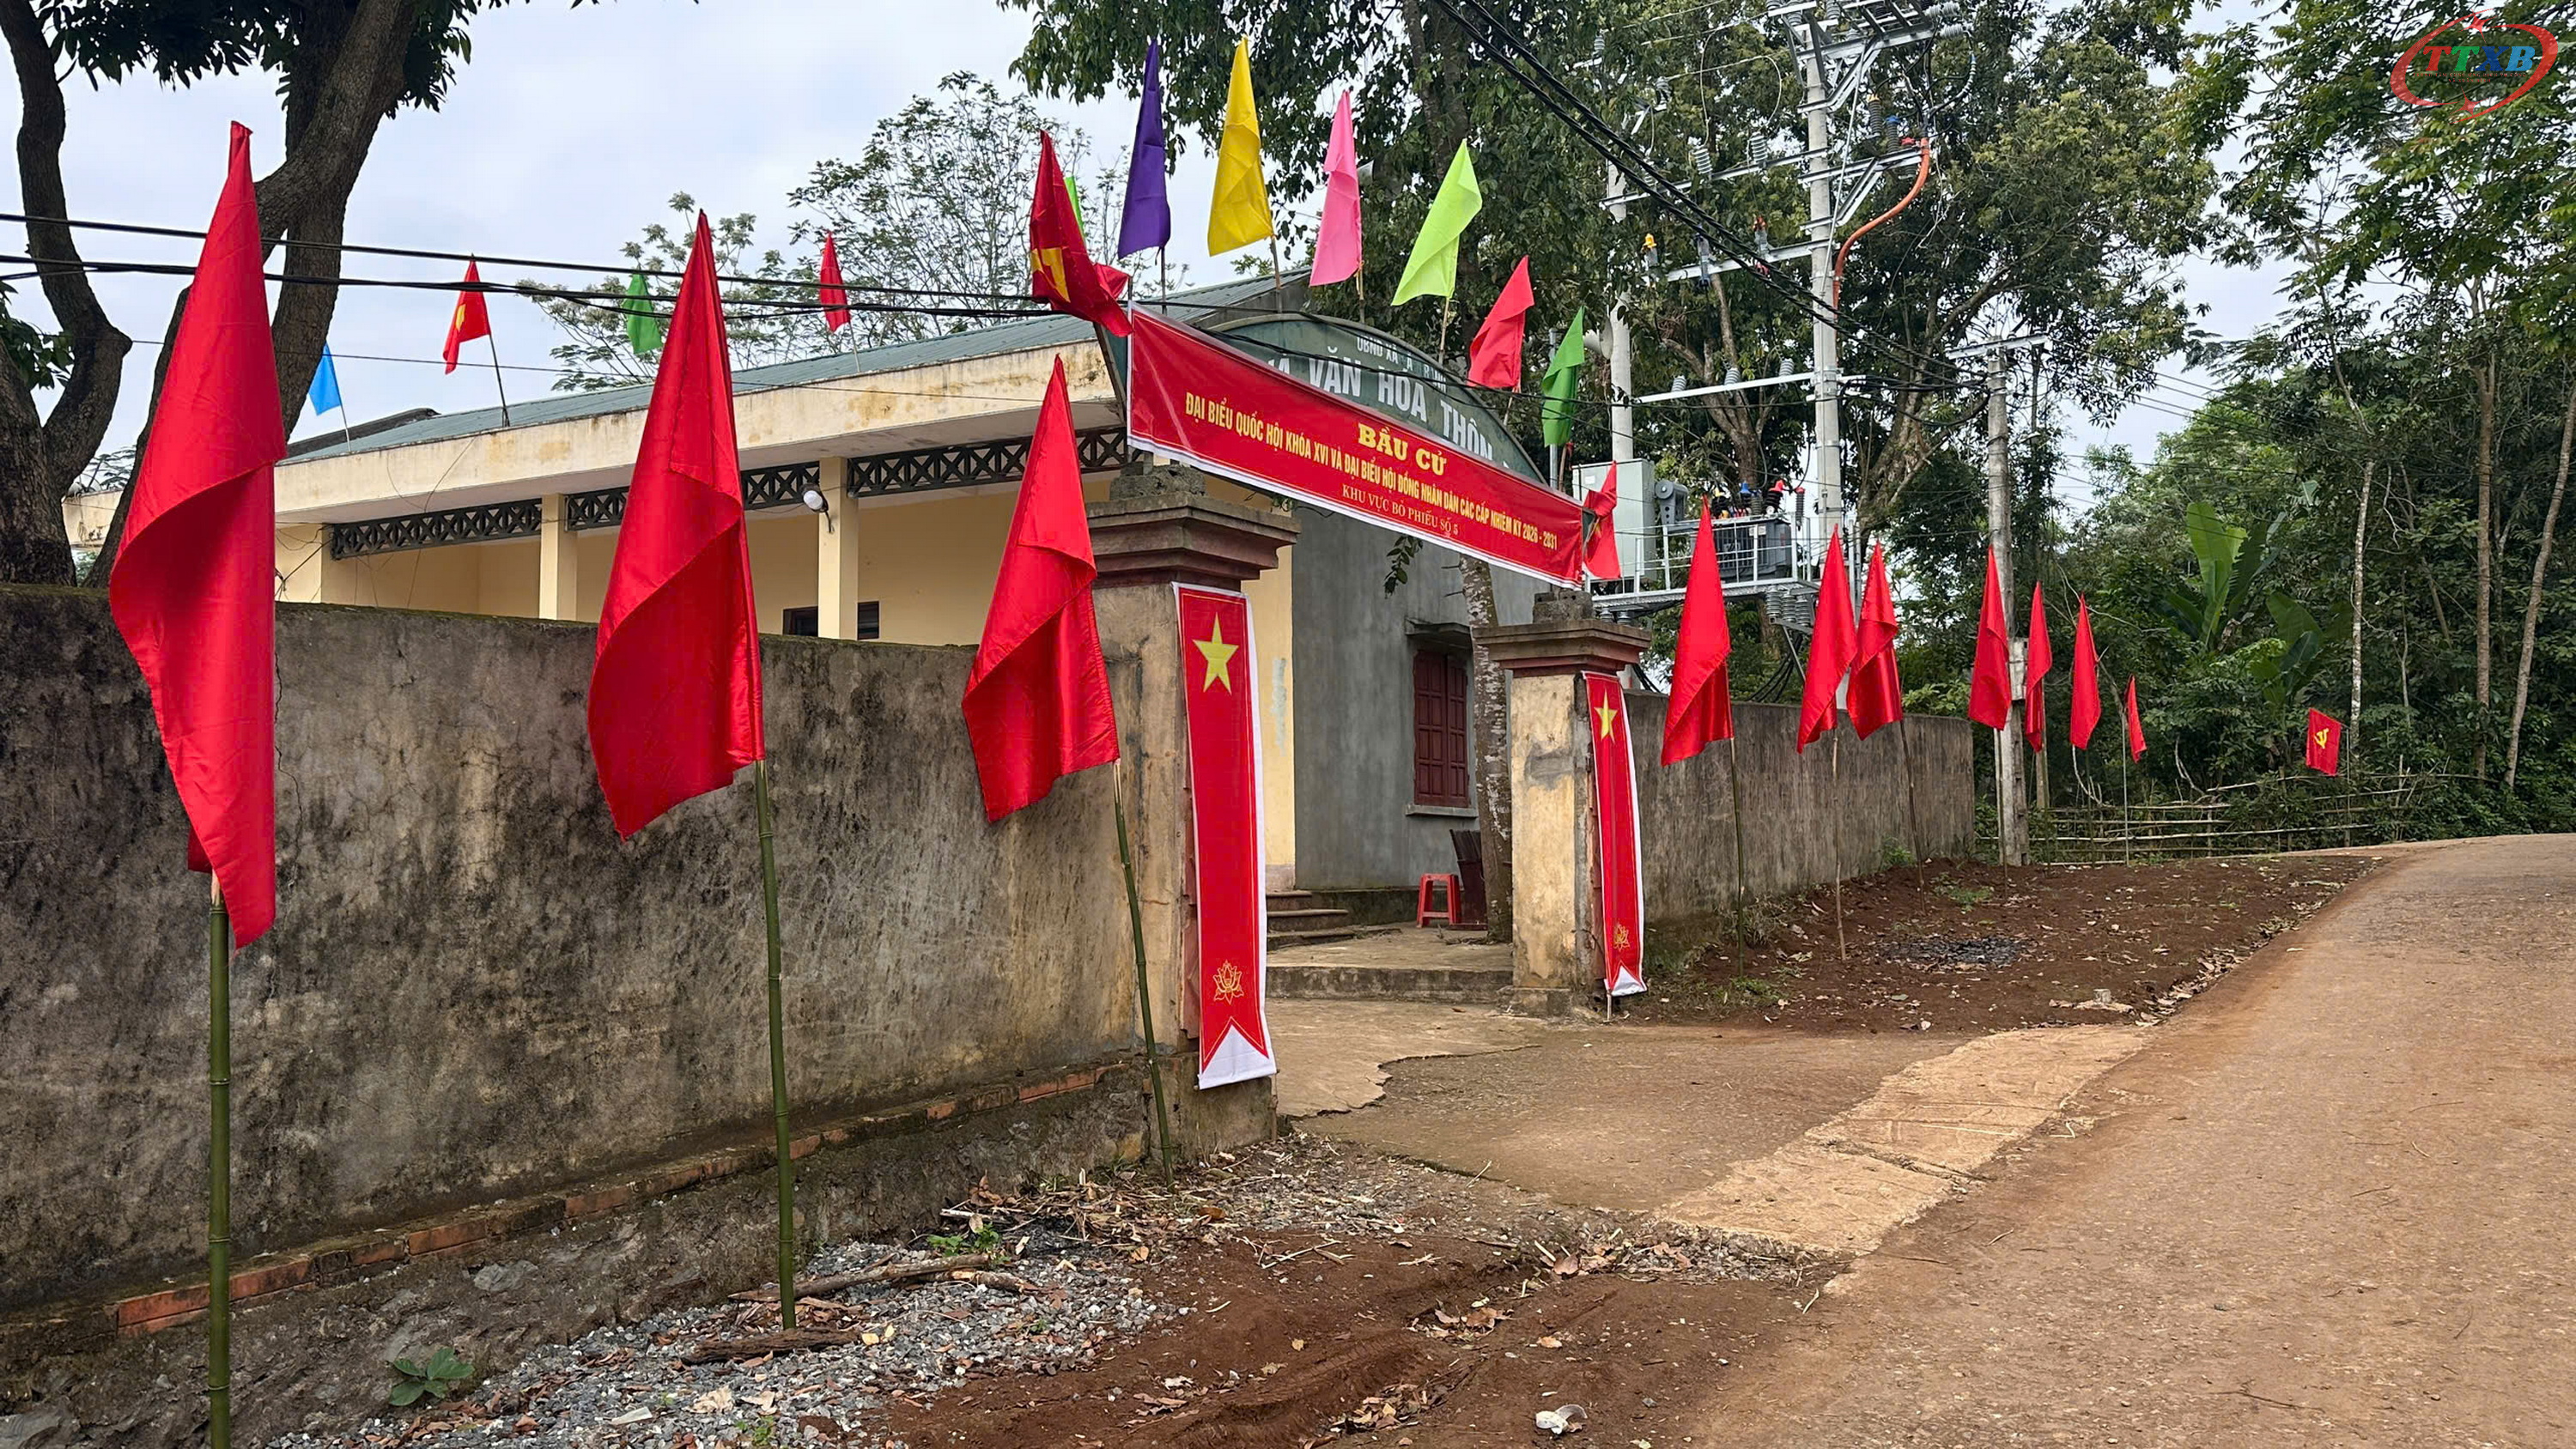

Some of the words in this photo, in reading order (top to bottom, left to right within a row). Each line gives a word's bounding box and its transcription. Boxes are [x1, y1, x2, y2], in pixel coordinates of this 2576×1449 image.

[1357, 334, 1383, 357] UBND
[1309, 346, 1362, 397] VĂN
[1440, 399, 1493, 461] THÔN
[1185, 391, 1206, 423] ĐẠI
[1207, 397, 1233, 430] BIỂU
[1236, 410, 1264, 441] QUỐC
[1266, 421, 1284, 452] HỘI
[1285, 430, 1311, 459] KHÓA
[1314, 441, 1329, 466] XVI
[1330, 445, 1343, 471] VÀ
[1344, 453, 1359, 480] ĐẠI
[1361, 456, 1381, 485] BIỂU
[1382, 466, 1396, 494] HỘI
[1398, 471, 1419, 498] ĐỒNG
[1420, 482, 1443, 508] NHÂN
[1443, 490, 1460, 514] DÂN
[1460, 497, 1474, 520] CÁC
[1475, 500, 1490, 524] CẤP
[1491, 510, 1513, 536] NHIỆM
[1522, 523, 1539, 544] 2026
[1543, 530, 1558, 551] 2031
[1358, 422, 1408, 461] BẦU
[1415, 447, 1447, 476] CỬ
[1342, 483, 1366, 504] KHU
[1368, 493, 1389, 512] VỰC
[1392, 499, 1406, 516] BỎ
[1407, 507, 1438, 528] PHIẾU
[1453, 524, 1459, 536] 5
